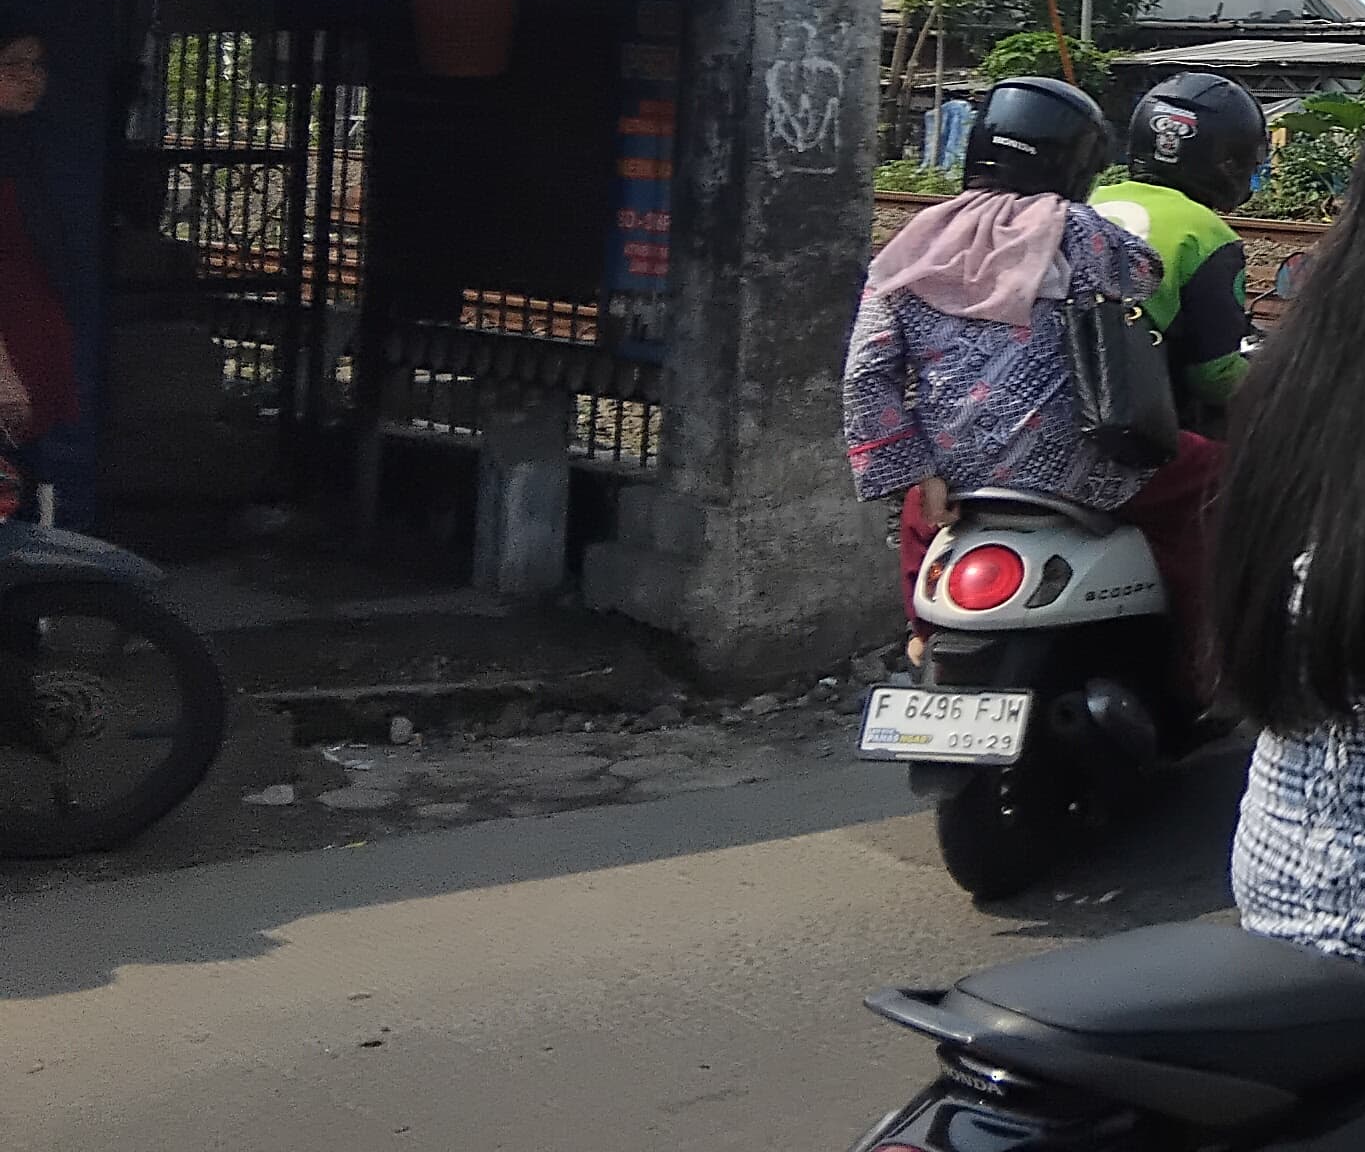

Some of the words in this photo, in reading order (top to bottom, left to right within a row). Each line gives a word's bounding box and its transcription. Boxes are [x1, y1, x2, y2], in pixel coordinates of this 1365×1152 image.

[875, 693, 892, 720] F
[904, 694, 963, 722] 6496
[973, 697, 1024, 724] FJW
